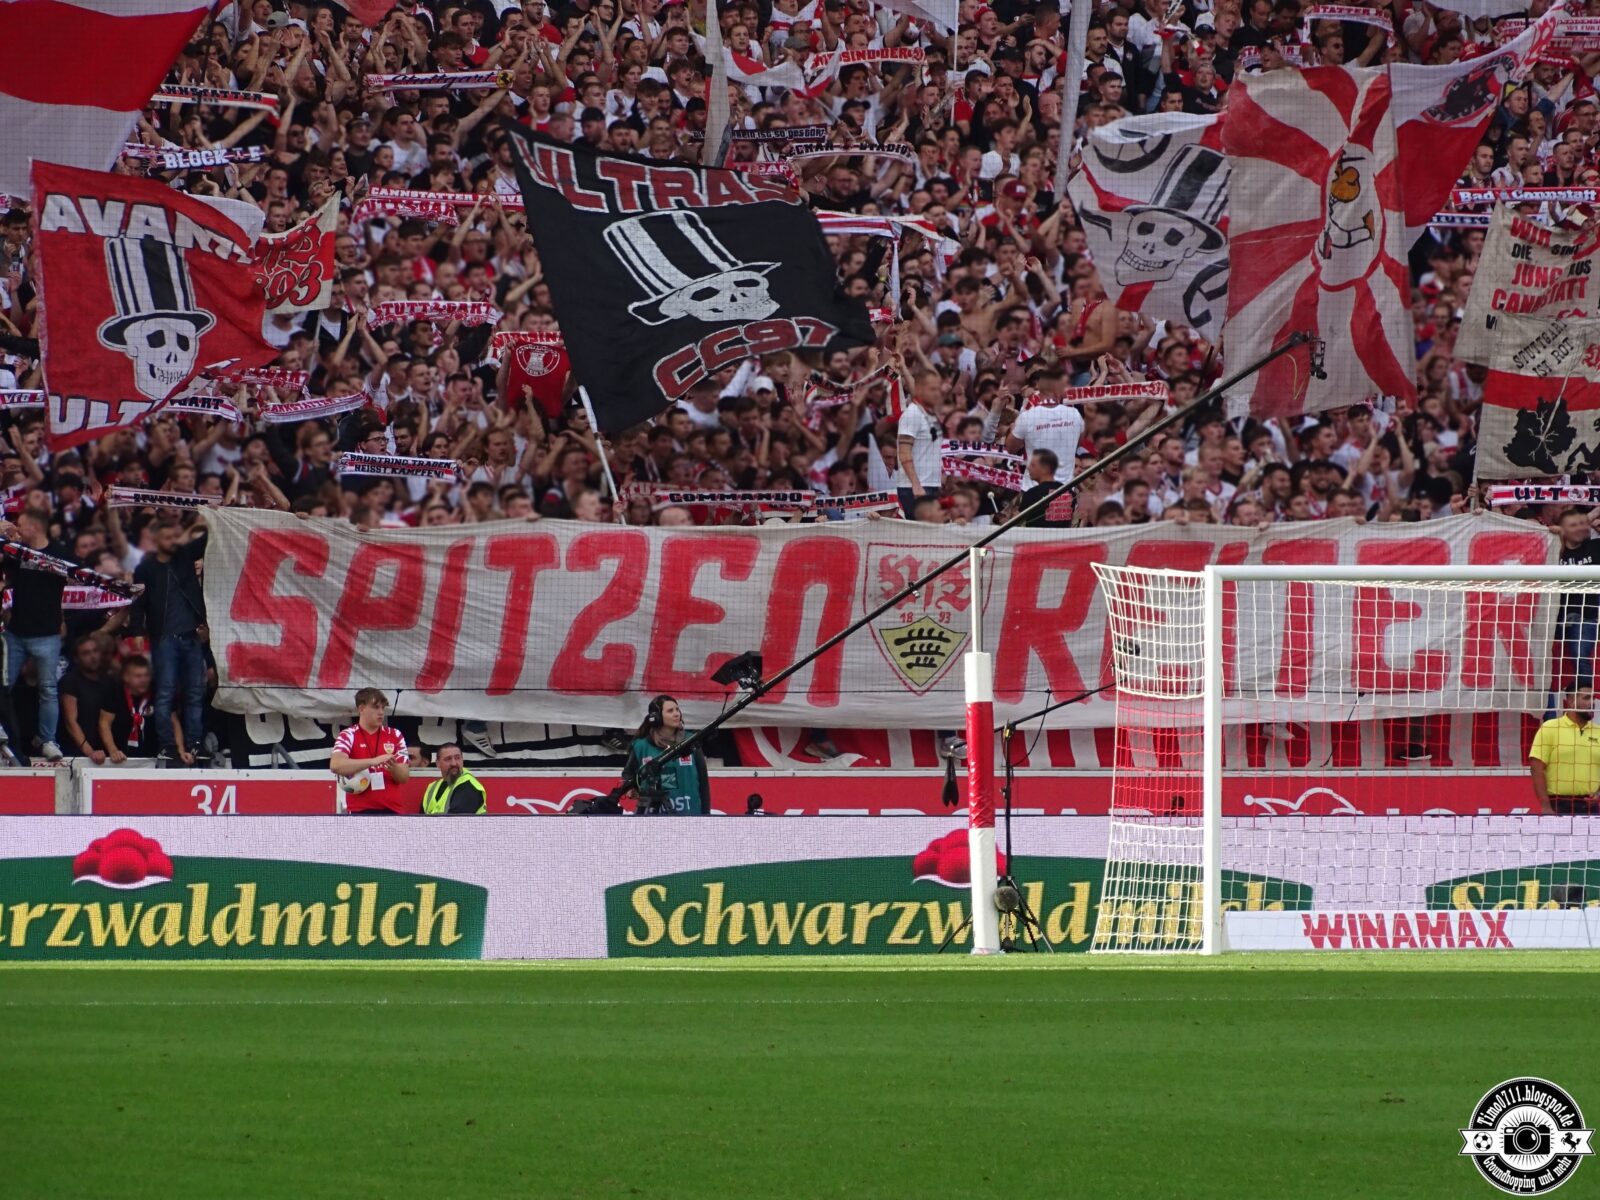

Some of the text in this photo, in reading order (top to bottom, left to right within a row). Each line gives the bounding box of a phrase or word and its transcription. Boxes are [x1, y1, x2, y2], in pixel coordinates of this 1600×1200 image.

[163, 149, 230, 169] BLOCK
[507, 129, 802, 213] ULTRAS
[371, 187, 473, 201] CANNSTATTER
[1459, 190, 1495, 202] Bad
[1511, 243, 1532, 260] DIE
[653, 317, 839, 401] CC97
[1532, 360, 1552, 377] IST
[1551, 337, 1574, 364] ROT
[669, 493, 802, 502] COMMANDO
[226, 529, 860, 707] SPITZEN
[0, 882, 463, 948] rzwaldmilch
[1301, 912, 1514, 948] WINAMAX
